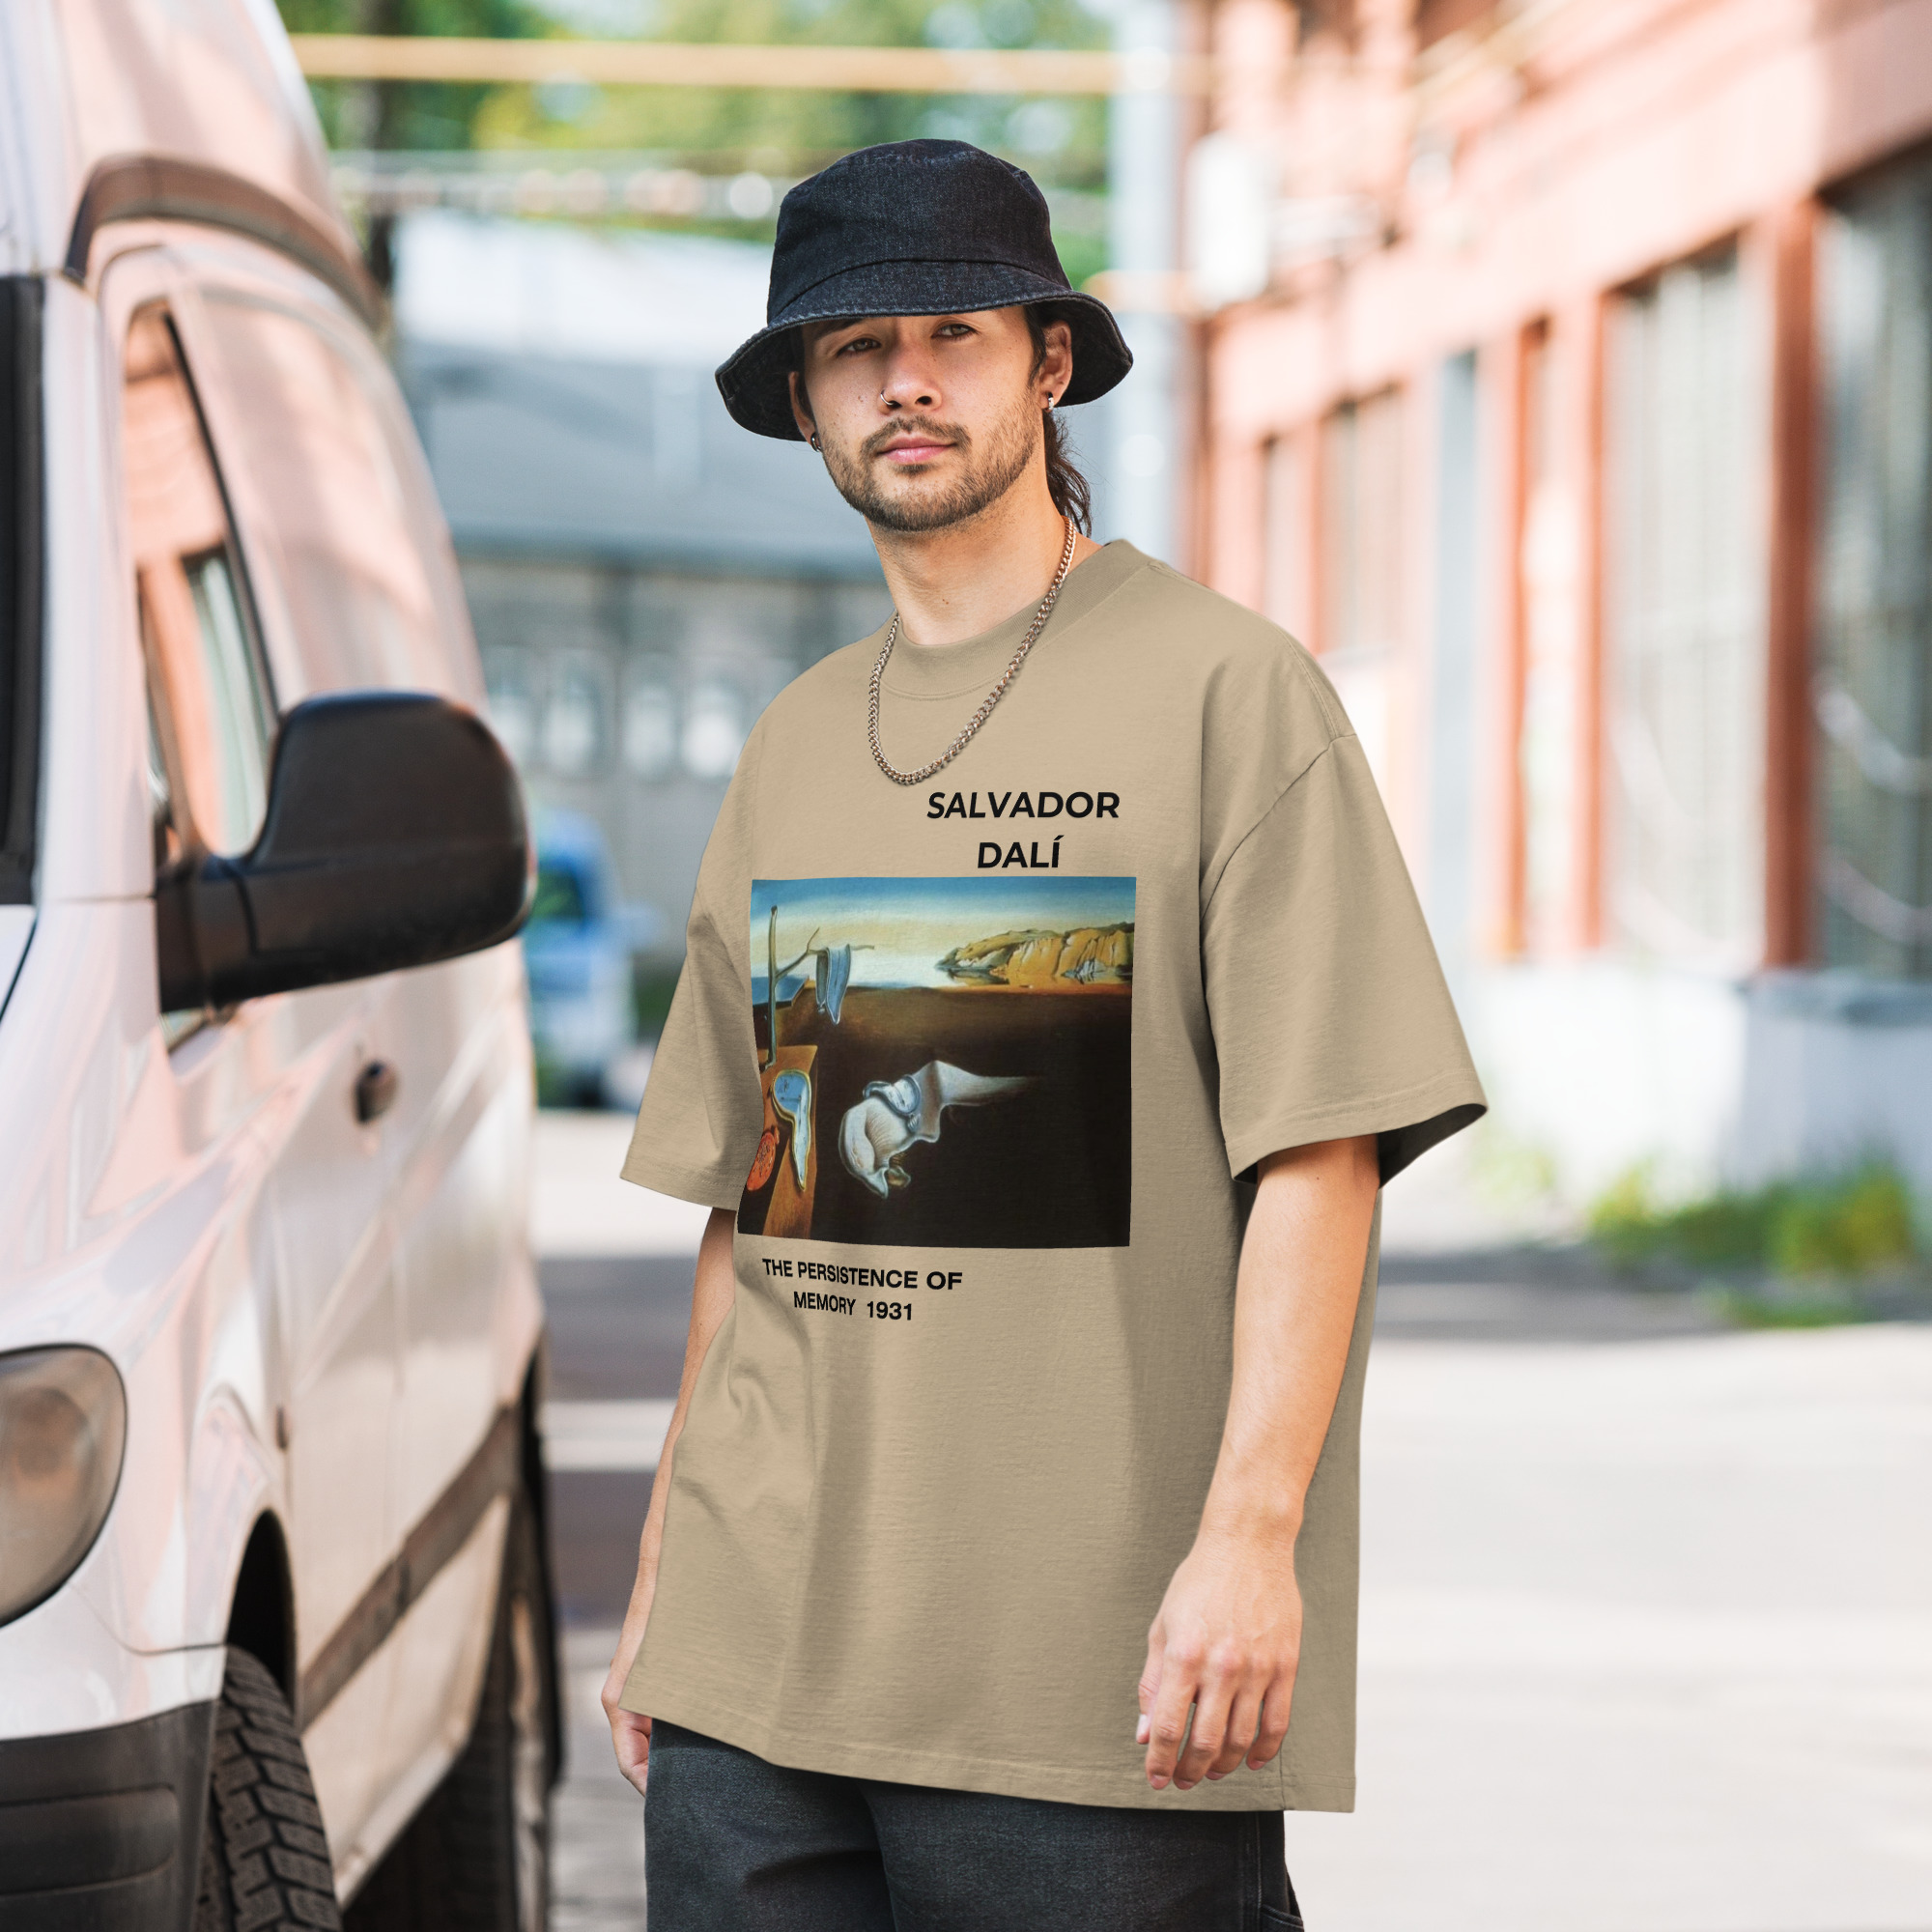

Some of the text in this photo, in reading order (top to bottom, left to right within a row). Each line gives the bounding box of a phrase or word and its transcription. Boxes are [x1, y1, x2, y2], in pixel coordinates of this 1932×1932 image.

[926, 791, 1121, 819] SALVADOR
[977, 835, 1065, 868] DALÍ
[761, 1258, 963, 1291] THE PERSISTENCE OF
[793, 1291, 912, 1321] MEMORY 1931
